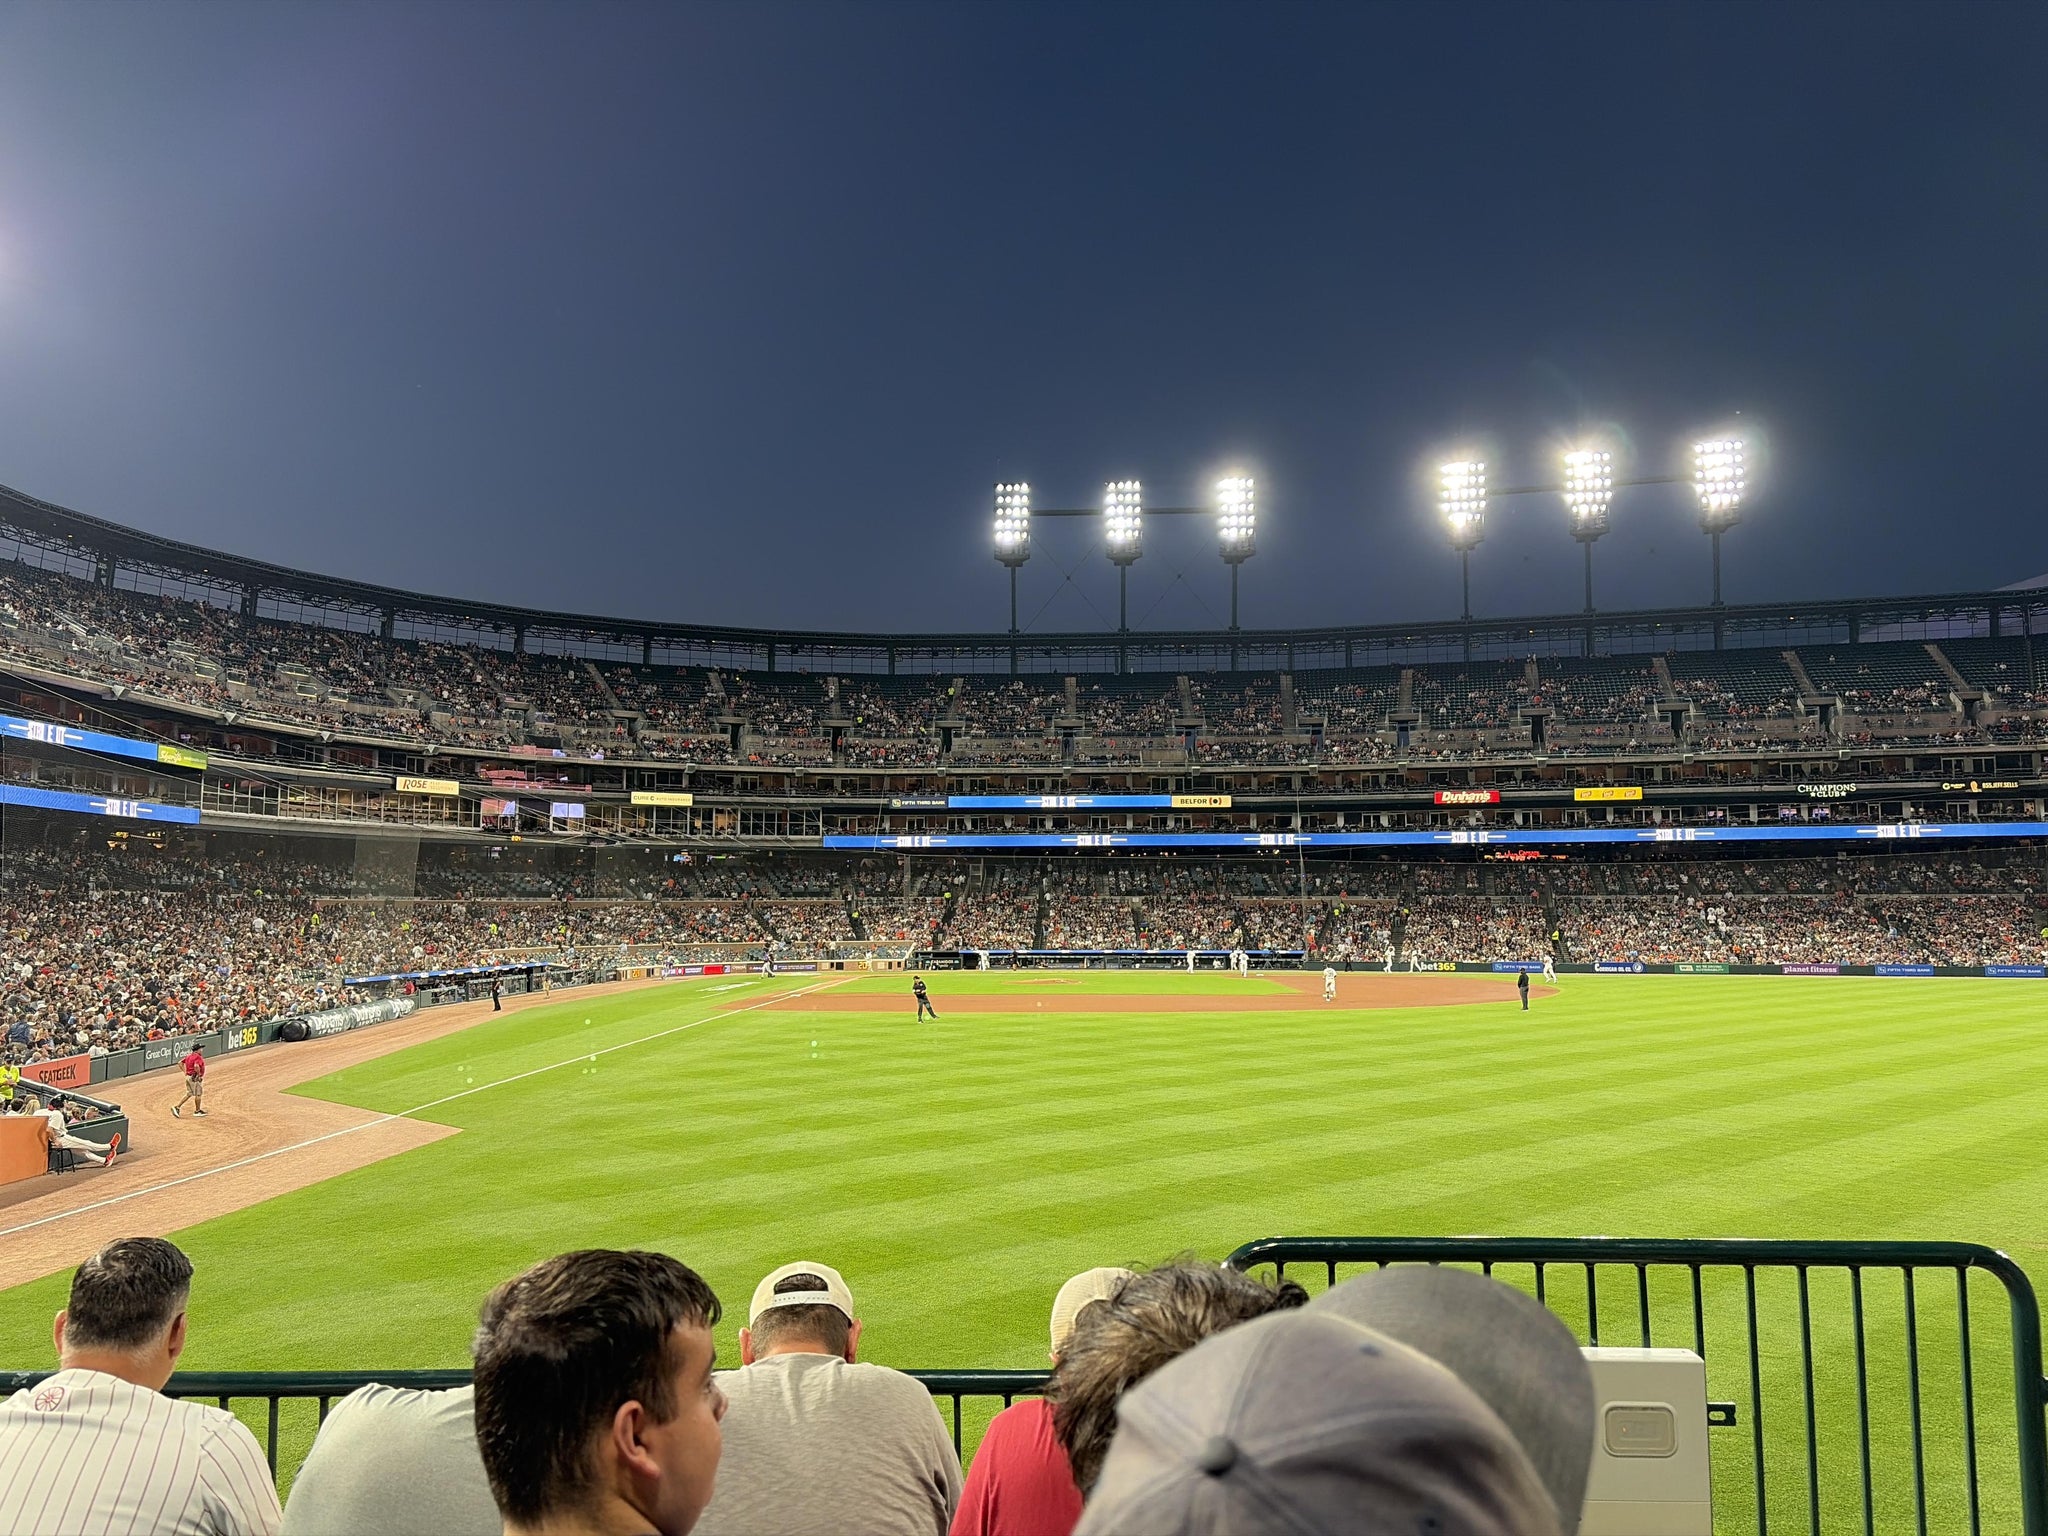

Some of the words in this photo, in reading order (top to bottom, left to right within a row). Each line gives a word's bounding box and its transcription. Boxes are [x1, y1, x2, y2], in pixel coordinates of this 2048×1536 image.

[403, 779, 428, 789] ROSE
[1797, 783, 1857, 793] CHAMPIONS
[1442, 790, 1491, 802] Dunham's
[1421, 963, 1456, 971] bet365
[1810, 965, 1837, 973] fitness
[228, 1026, 258, 1050] bet365
[146, 1050, 161, 1060] Great
[160, 1047, 172, 1059] Clips
[39, 1064, 77, 1084] SEATGEEK
